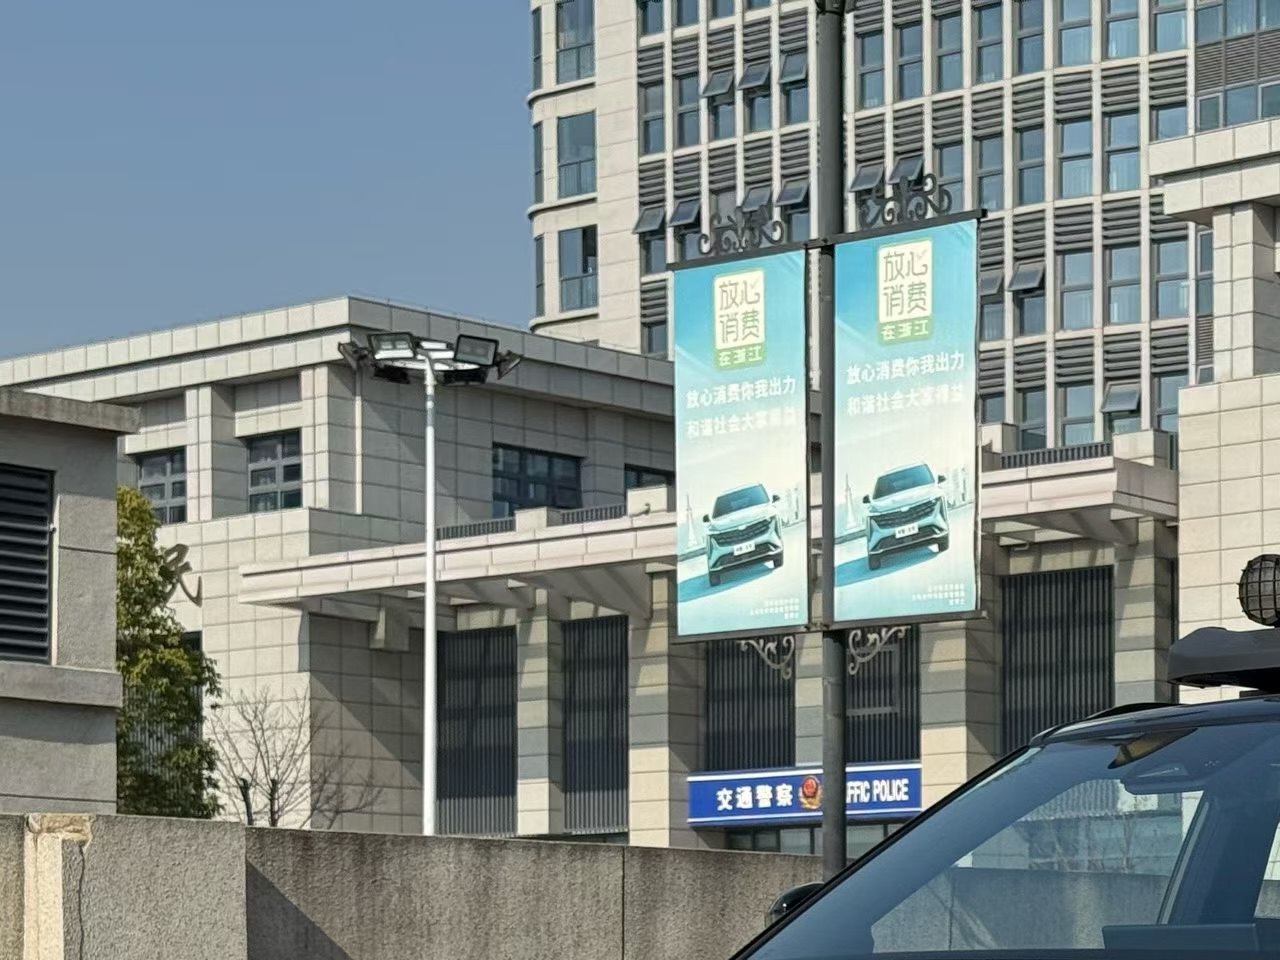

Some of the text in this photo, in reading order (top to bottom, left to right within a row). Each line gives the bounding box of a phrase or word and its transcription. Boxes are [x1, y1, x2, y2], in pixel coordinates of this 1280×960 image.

[883, 250, 928, 283] 放心
[719, 280, 761, 311] 放心
[883, 281, 927, 317] 消费
[719, 310, 760, 344] 消费
[846, 351, 965, 385] 放心消费你我出力
[717, 783, 793, 811] 交通警察
[846, 778, 909, 803] FFIC POLICE
